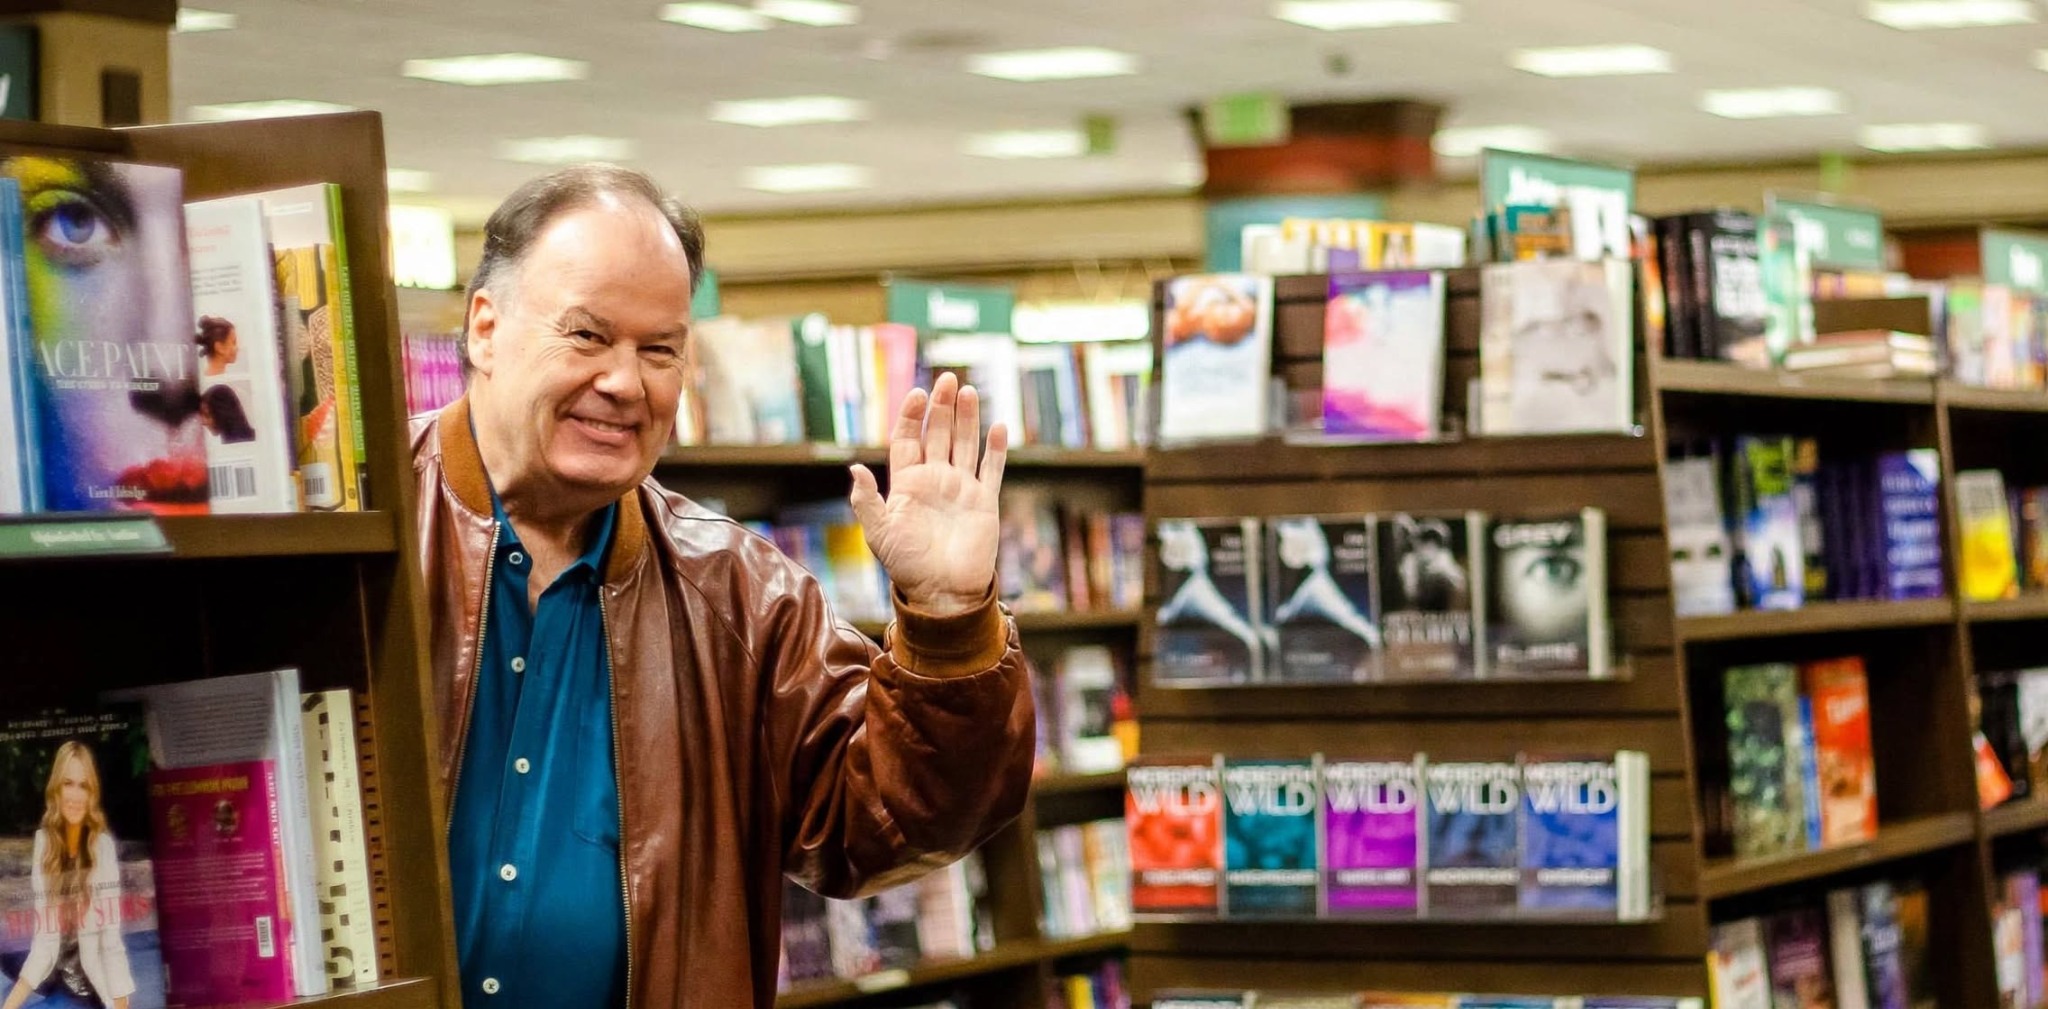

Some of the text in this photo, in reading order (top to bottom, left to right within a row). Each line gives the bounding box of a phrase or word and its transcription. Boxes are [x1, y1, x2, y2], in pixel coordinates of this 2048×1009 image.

[33, 340, 190, 381] ACE PAINT
[1130, 781, 1217, 816] WILD
[1226, 781, 1317, 816] WILD
[1327, 779, 1417, 814] WILD
[1428, 779, 1520, 815] WILD
[1526, 779, 1618, 815] WILD
